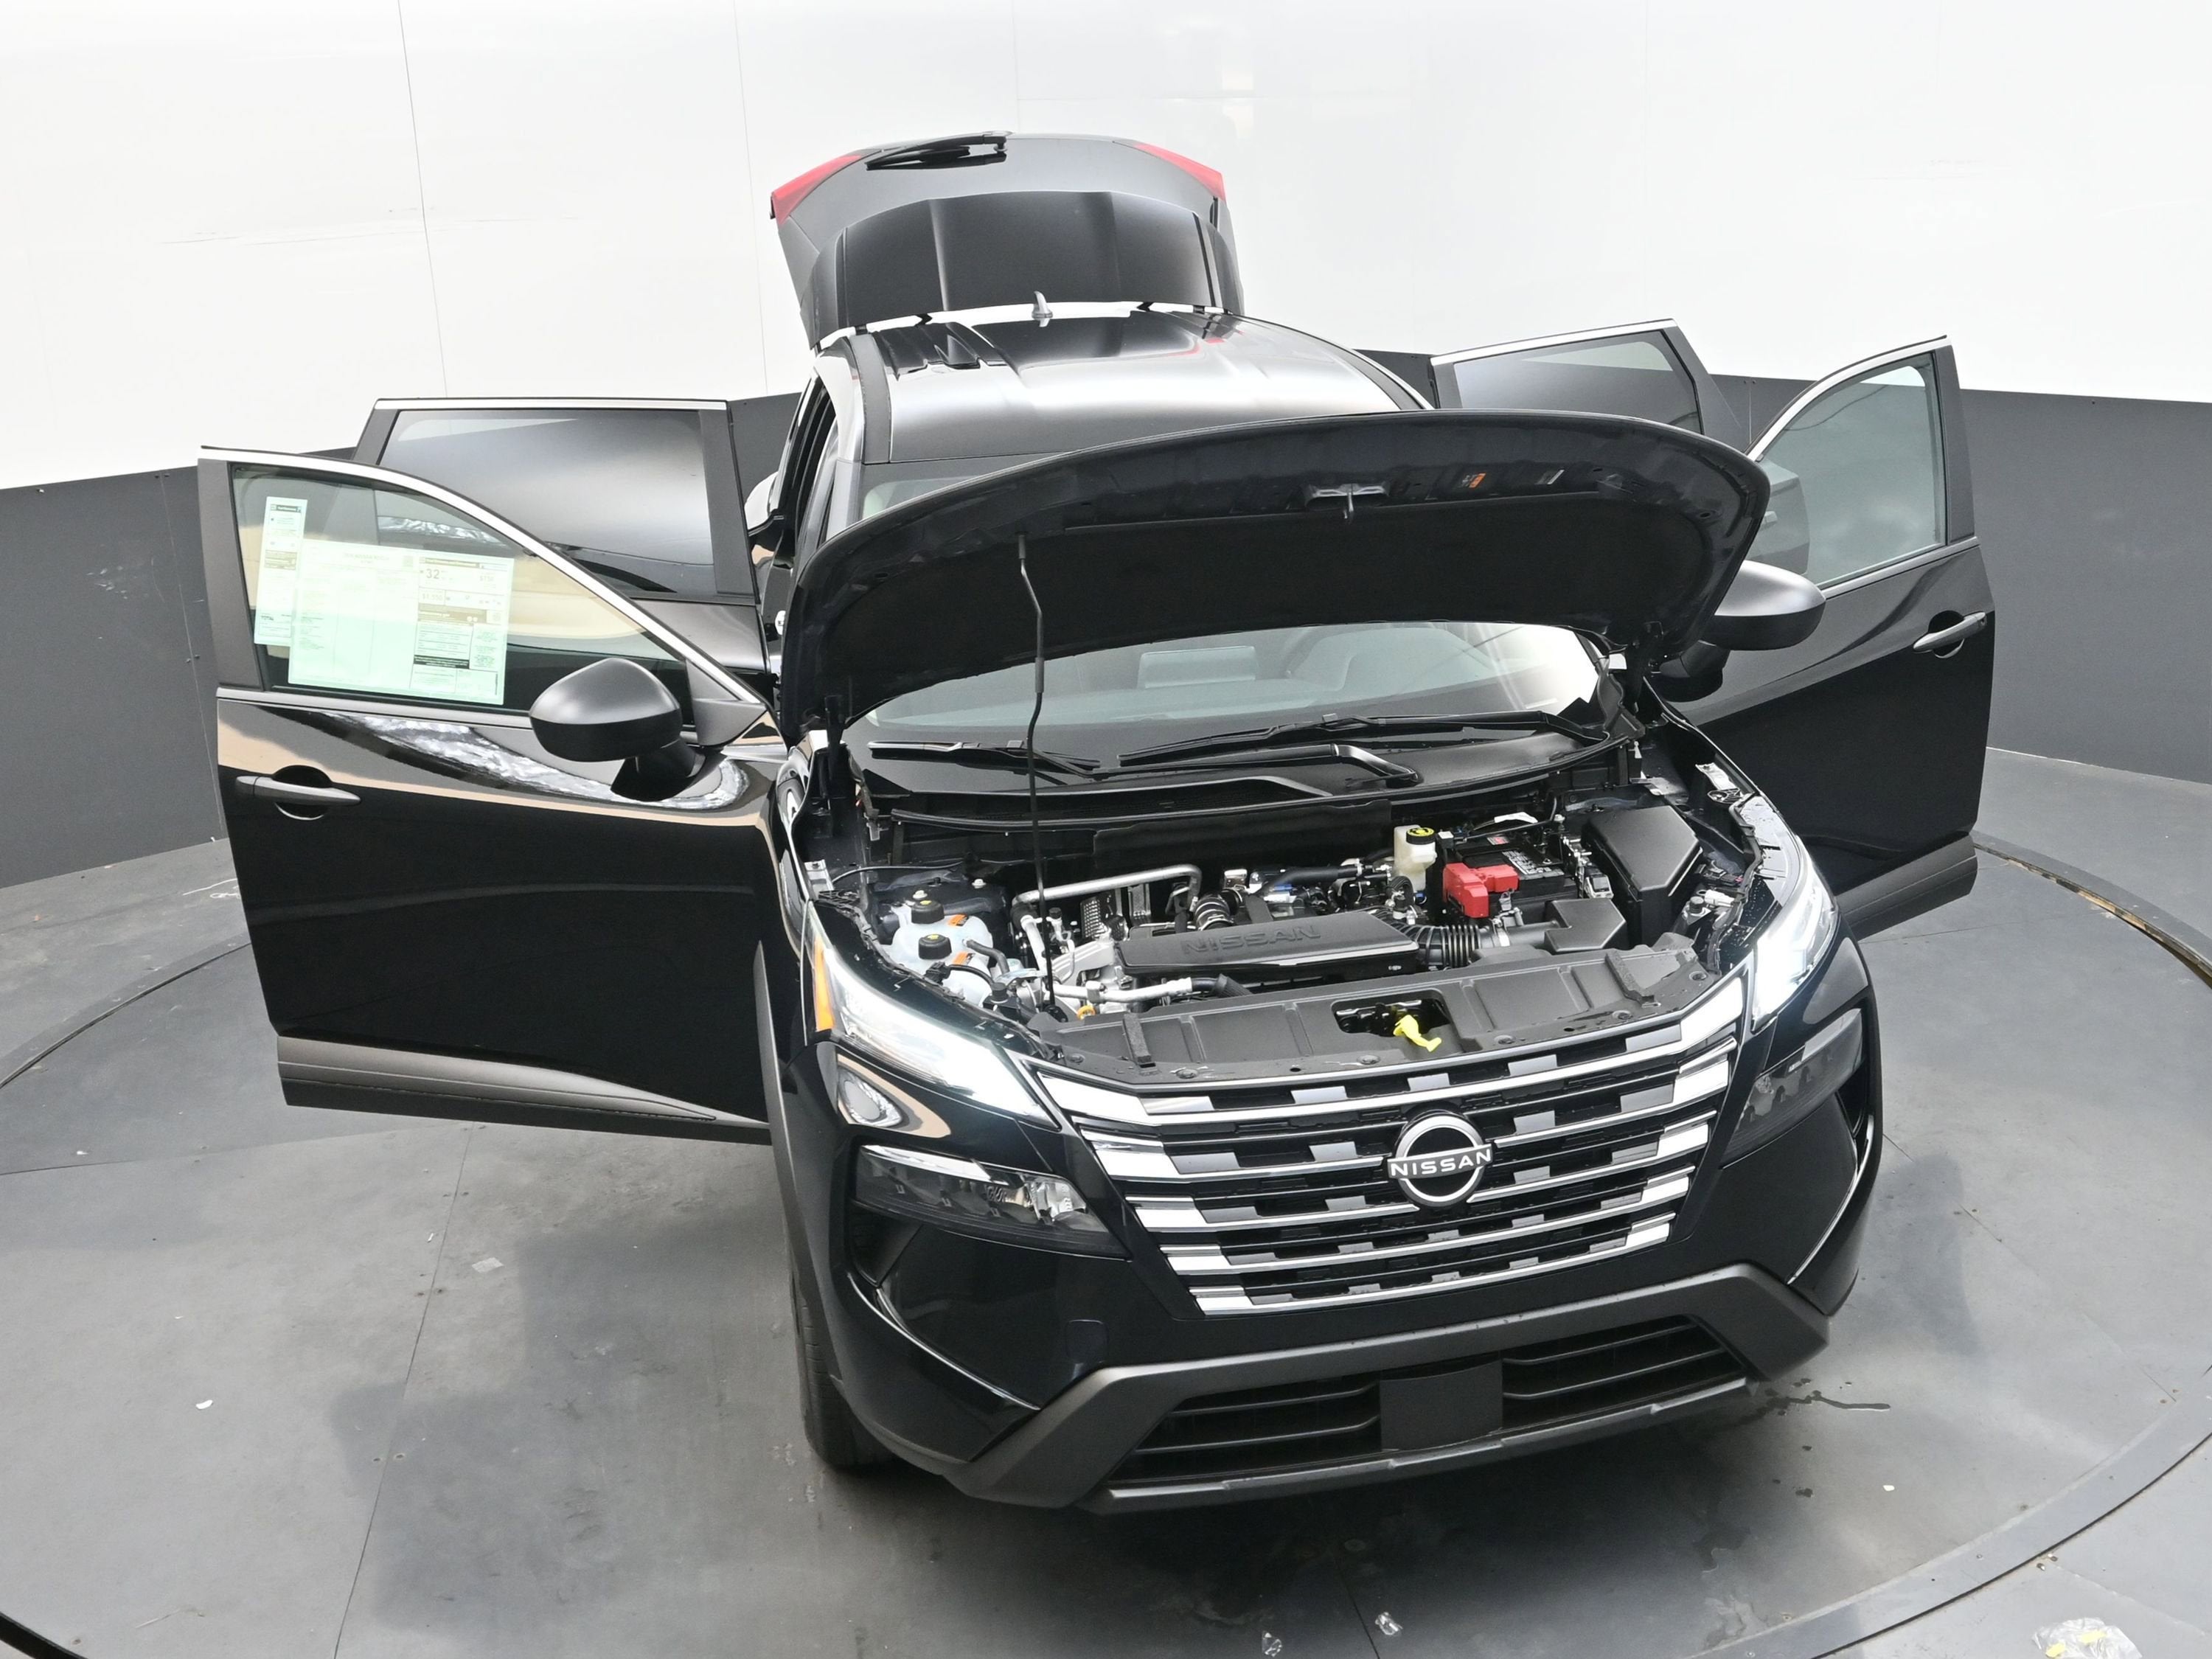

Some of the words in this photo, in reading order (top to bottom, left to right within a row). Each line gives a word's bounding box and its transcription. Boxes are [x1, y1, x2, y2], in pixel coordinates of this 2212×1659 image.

[426, 568, 440, 580] 32
[1181, 925, 1322, 955] NISSAN
[1391, 1149, 1492, 1177] NISSAN
